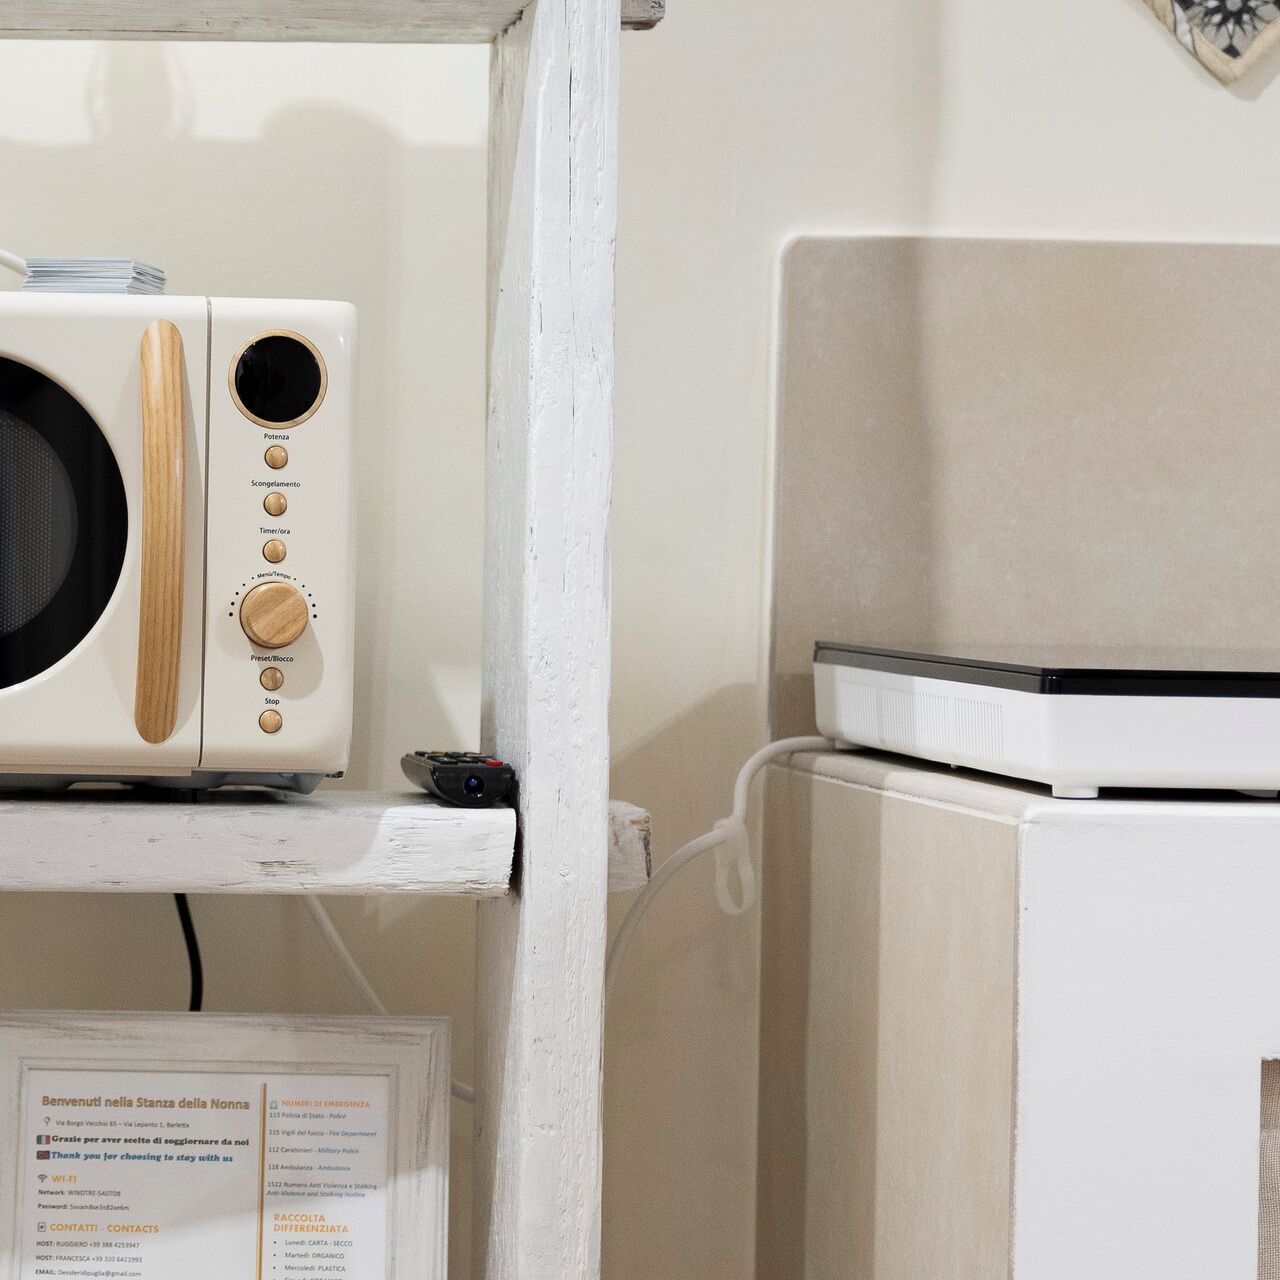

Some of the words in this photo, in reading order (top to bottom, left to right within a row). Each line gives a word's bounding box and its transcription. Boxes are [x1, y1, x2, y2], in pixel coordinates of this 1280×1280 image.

[264, 433, 290, 441] Potenza
[251, 480, 301, 488] Scongelamento
[259, 527, 291, 535] Timer/ora
[250, 655, 294, 663] Preset/Blocco
[105, 1097, 134, 1107] nella
[136, 1097, 176, 1108] Stanza
[179, 1098, 208, 1109] della
[211, 1099, 250, 1109] Nonna
[51, 1135, 81, 1143] Grazie
[84, 1137, 99, 1145] per
[124, 1136, 150, 1144] scelto
[164, 1137, 219, 1147] soggiornare
[235, 1138, 249, 1146] noi
[51, 1151, 81, 1159] Thank
[84, 1153, 101, 1161] you
[104, 1152, 117, 1161] for
[121, 1152, 161, 1162] choosing
[164, 1153, 173, 1161] to
[176, 1154, 196, 1163] stay
[199, 1154, 220, 1162] with
[52, 1174, 77, 1183] WI-FI
[274, 1213, 325, 1223] RACCOLTA
[50, 1223, 98, 1232] CONTATTI
[107, 1224, 160, 1233] CONTACTS
[274, 1224, 348, 1233] DIFFERENZIATA
